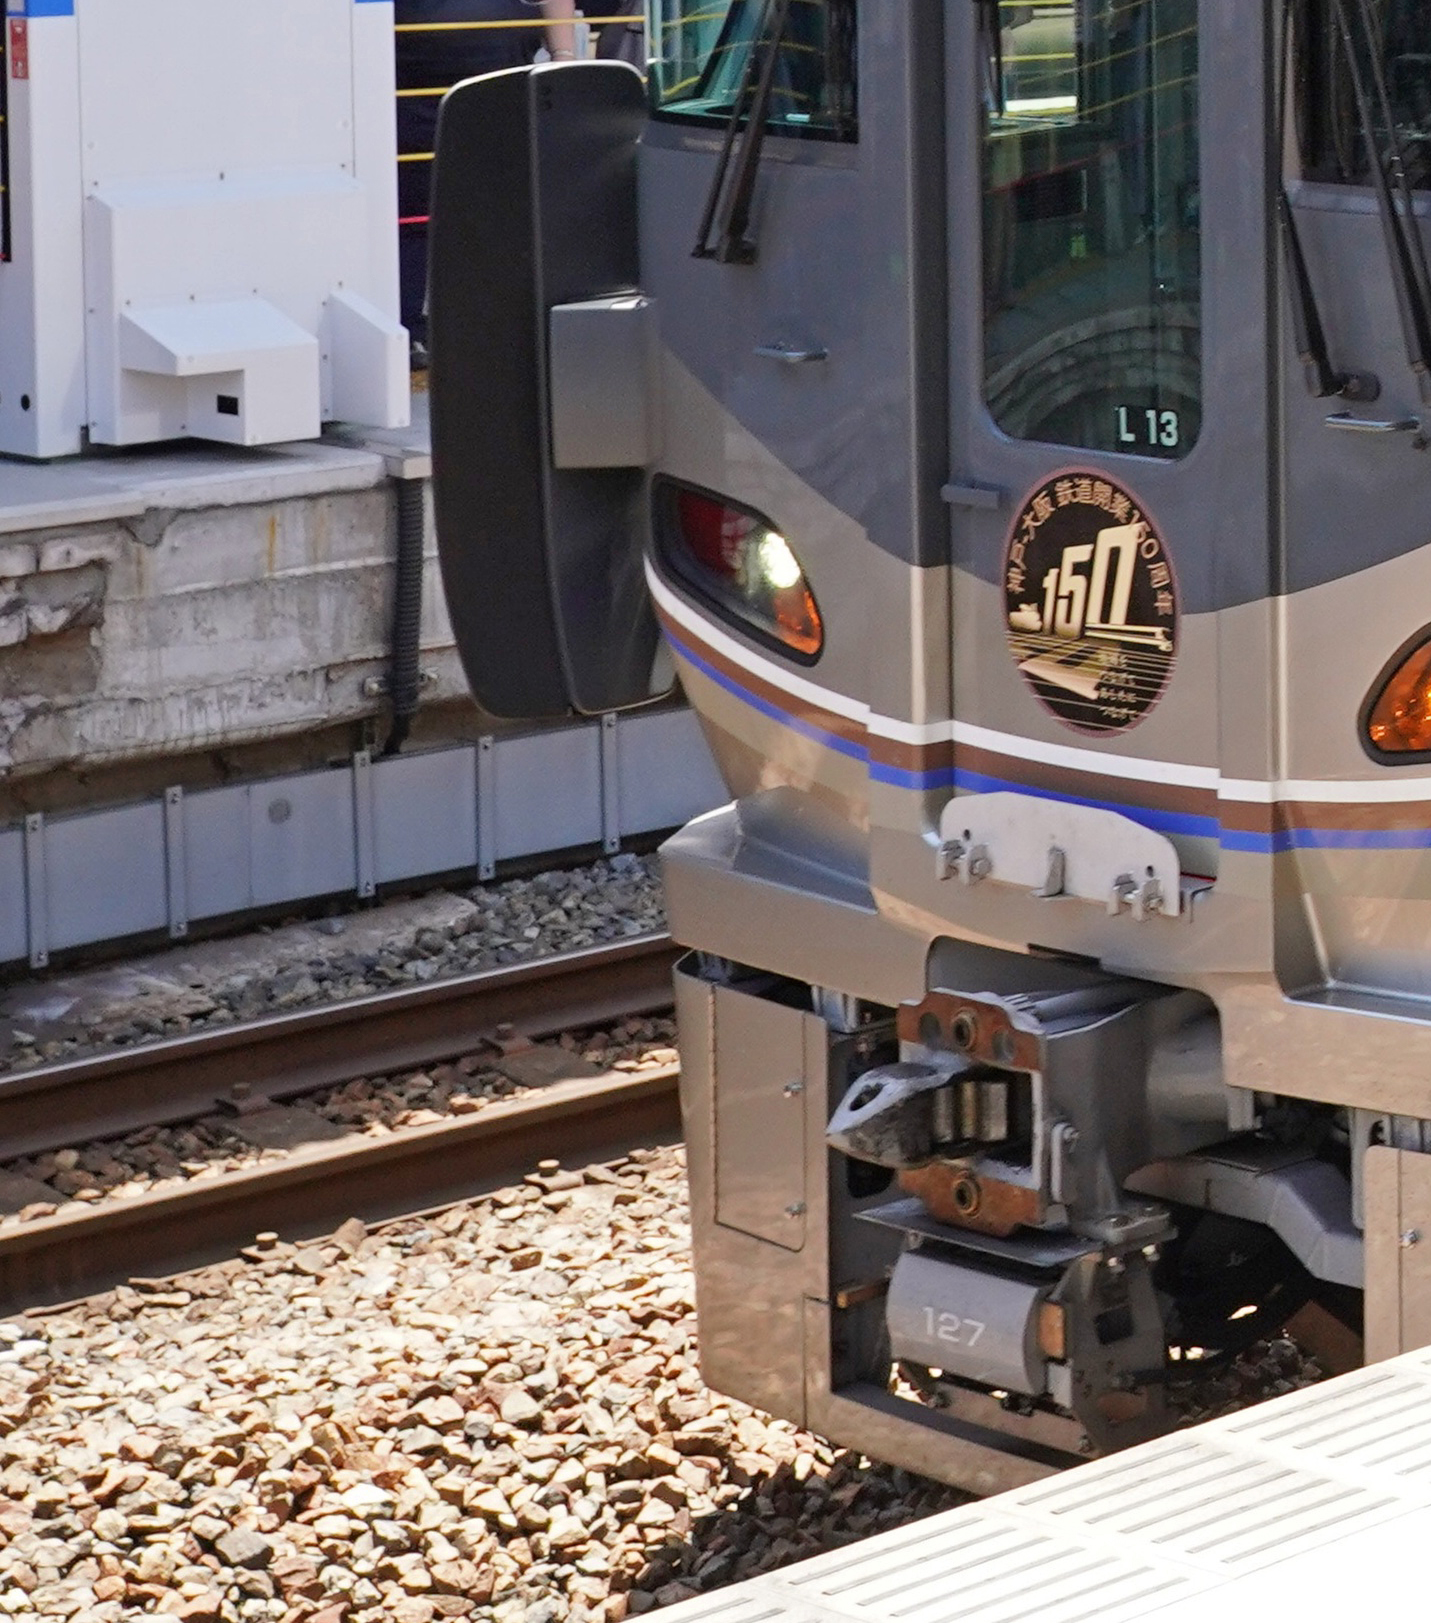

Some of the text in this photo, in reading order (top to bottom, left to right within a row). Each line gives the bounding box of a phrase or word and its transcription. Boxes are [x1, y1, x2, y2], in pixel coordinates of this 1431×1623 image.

[1119, 406, 1178, 448] L 13
[1042, 521, 1152, 641] 150
[922, 1306, 985, 1347] 127
